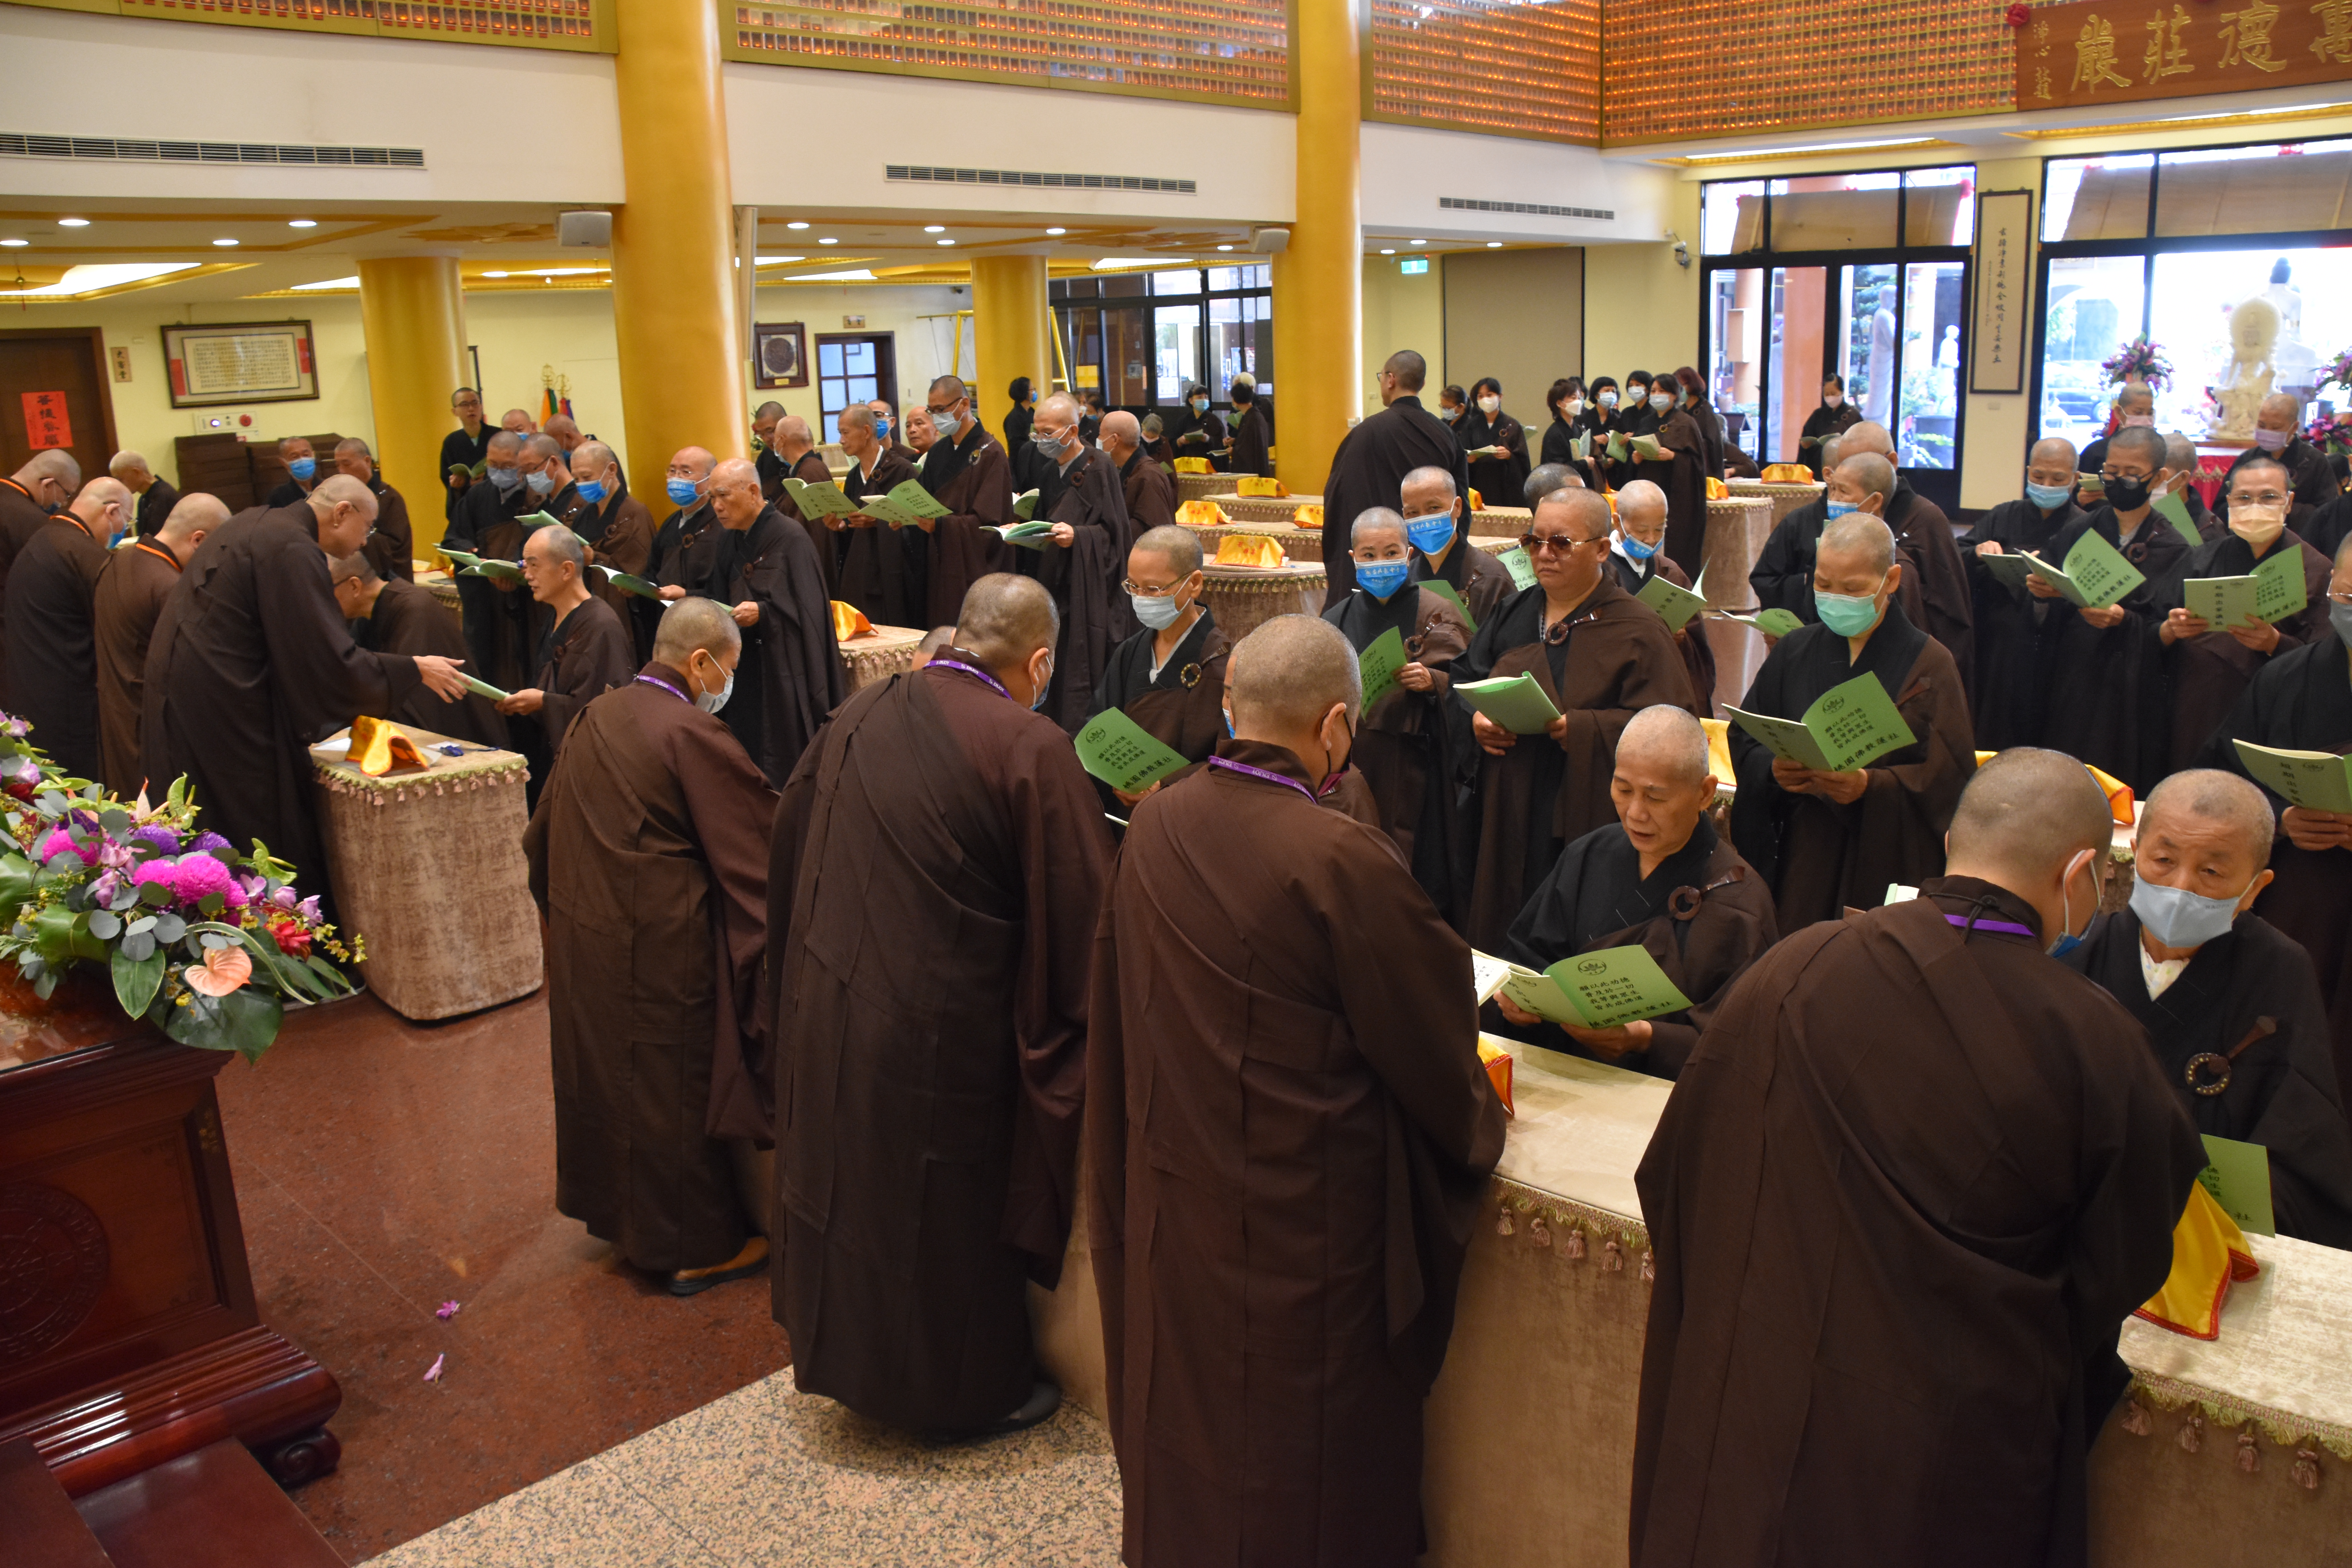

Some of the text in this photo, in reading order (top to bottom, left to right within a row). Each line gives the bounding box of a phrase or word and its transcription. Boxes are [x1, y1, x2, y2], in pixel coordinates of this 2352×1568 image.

[966, 666, 979, 675] ENJOY
[993, 682, 1004, 692] ENJOY
[1218, 759, 1232, 767] ENJOY
[1123, 756, 1173, 789] 桃園佛教蓮社
[1252, 768, 1270, 779] ENJOY
[1579, 976, 1630, 991] 願以此功德
[1585, 984, 1634, 998] 普及於一切
[1590, 990, 1640, 1005] 我等與眾生
[1594, 995, 1644, 1010] 皆共成佛道
[1588, 1001, 1673, 1029] 桃園佛教蓮社
